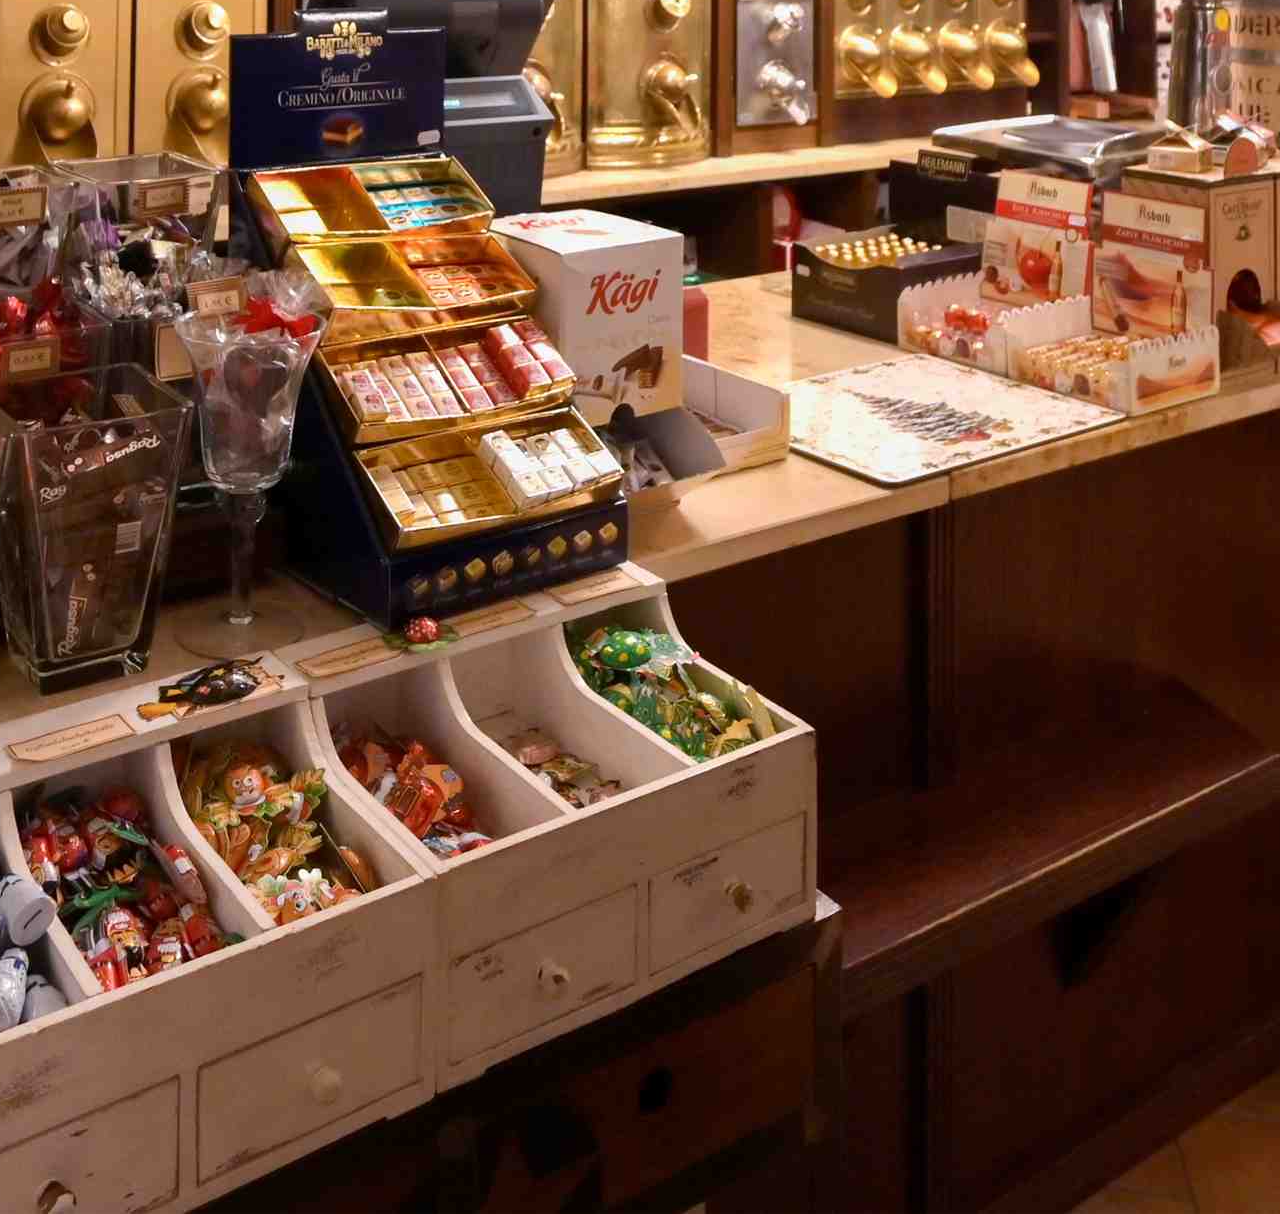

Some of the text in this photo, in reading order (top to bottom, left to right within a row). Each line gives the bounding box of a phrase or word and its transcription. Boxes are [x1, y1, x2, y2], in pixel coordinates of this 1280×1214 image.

[277, 89, 335, 107] CREMINO
[585, 269, 662, 316] Kägi
[105, 433, 162, 464] Ragusa
[57, 597, 82, 659] Ragusa
